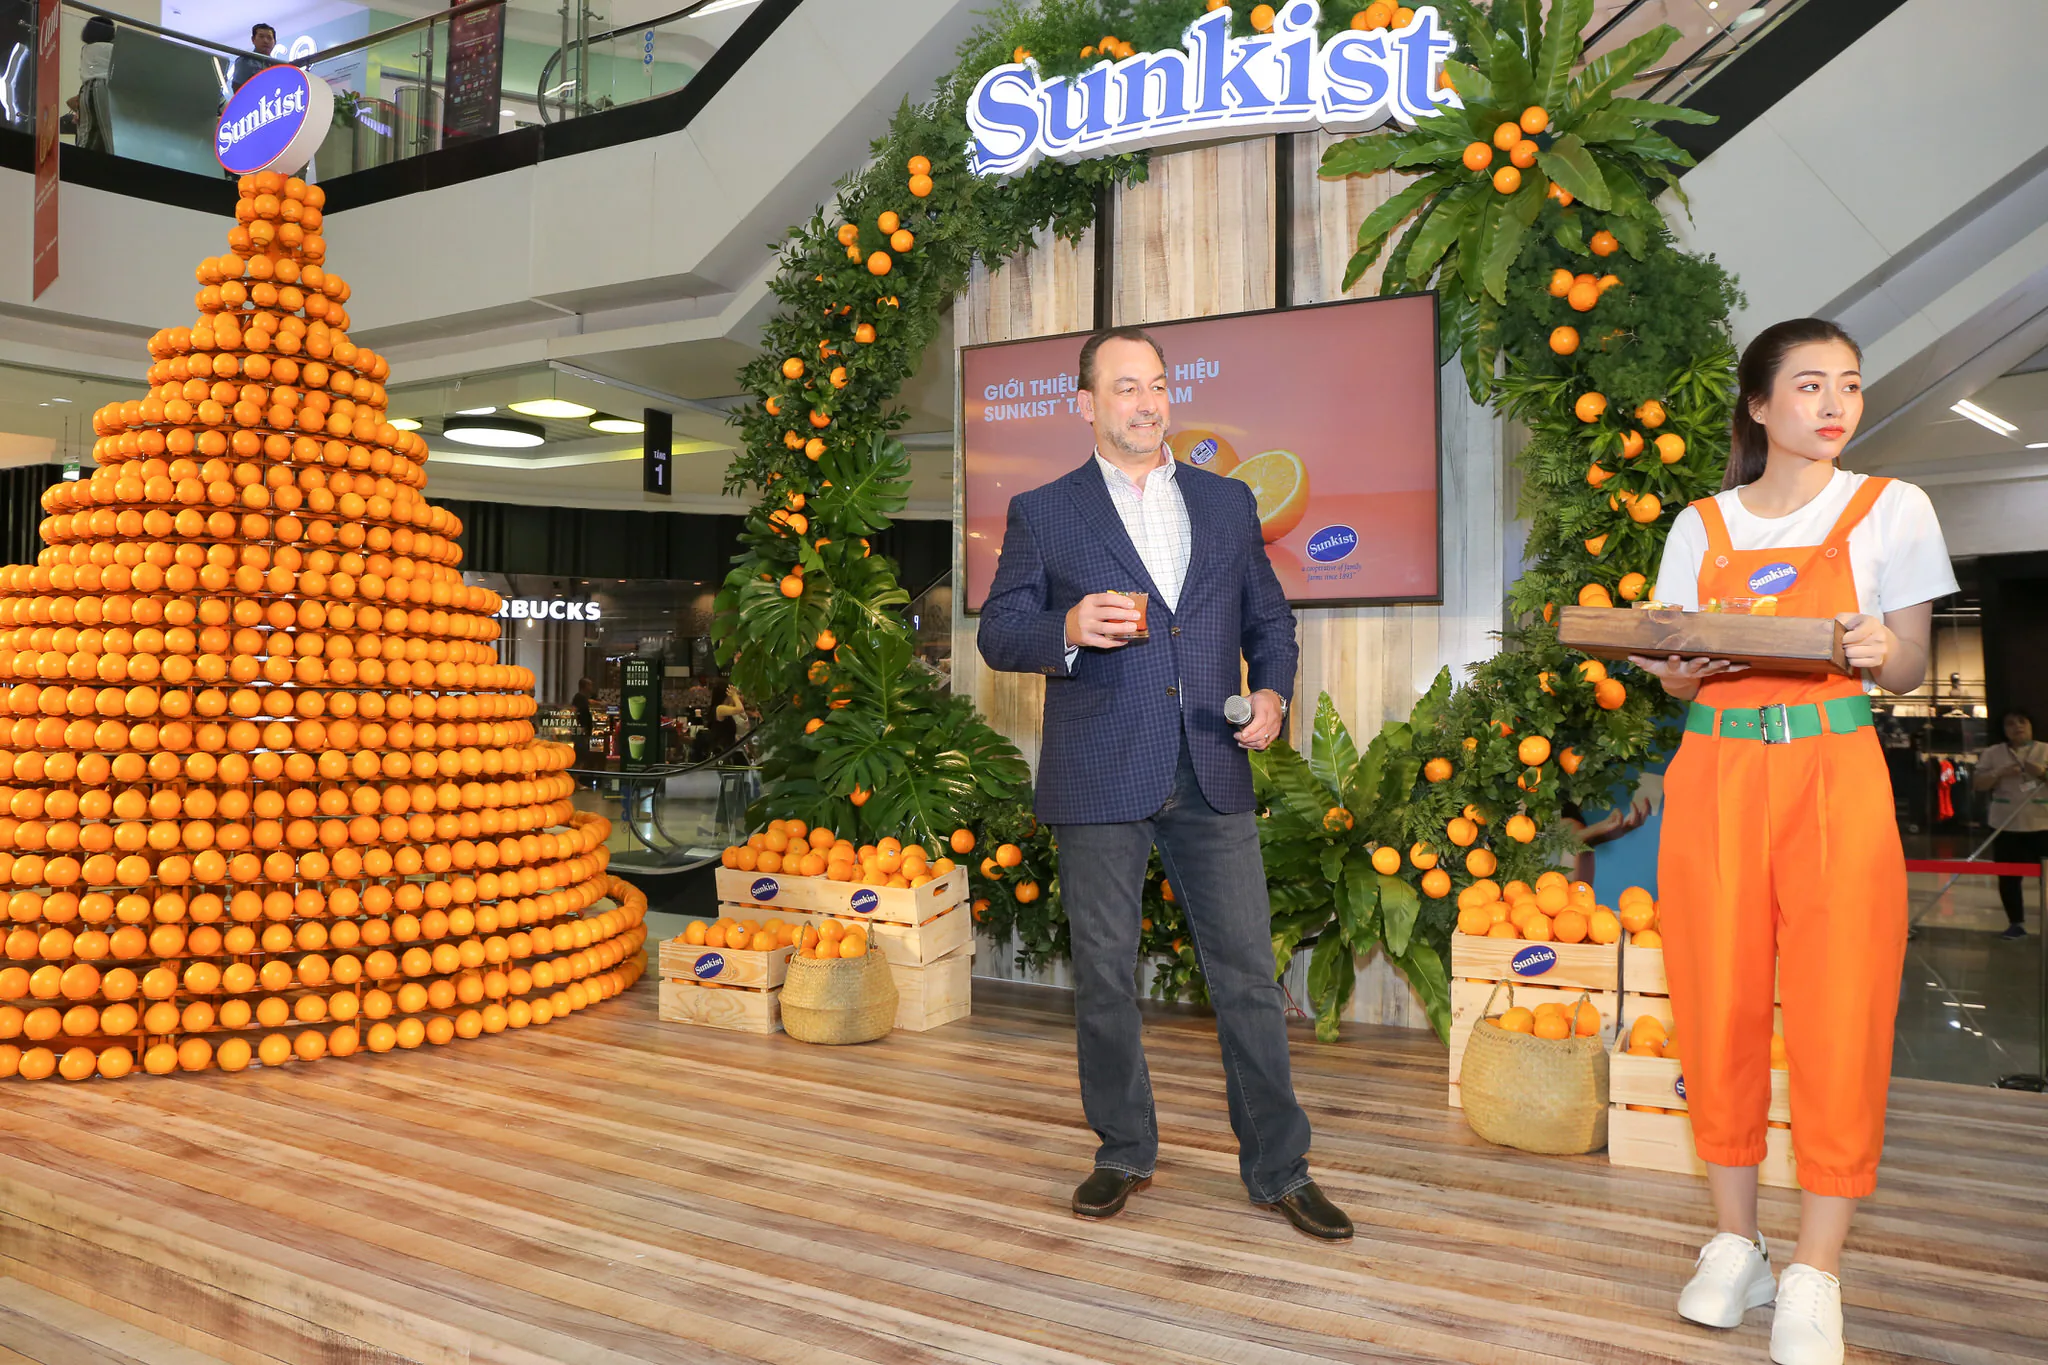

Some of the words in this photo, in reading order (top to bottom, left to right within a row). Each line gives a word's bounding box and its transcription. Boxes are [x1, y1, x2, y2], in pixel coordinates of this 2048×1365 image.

[968, 0, 1458, 176] Sunkist
[217, 85, 305, 156] Sunkist
[984, 378, 1024, 401] GIỚI
[1030, 372, 1079, 398] THIỆU
[1175, 357, 1219, 384] HIỆU
[655, 464, 663, 485] 1
[1309, 533, 1355, 555] Sunkist
[1750, 566, 1797, 590] Sunkist
[491, 599, 601, 620] RBUCKS
[751, 882, 777, 896] Sunkist
[851, 895, 877, 909] Sunkist
[694, 957, 723, 975] Sunkist
[1513, 950, 1555, 972] Sunkist
